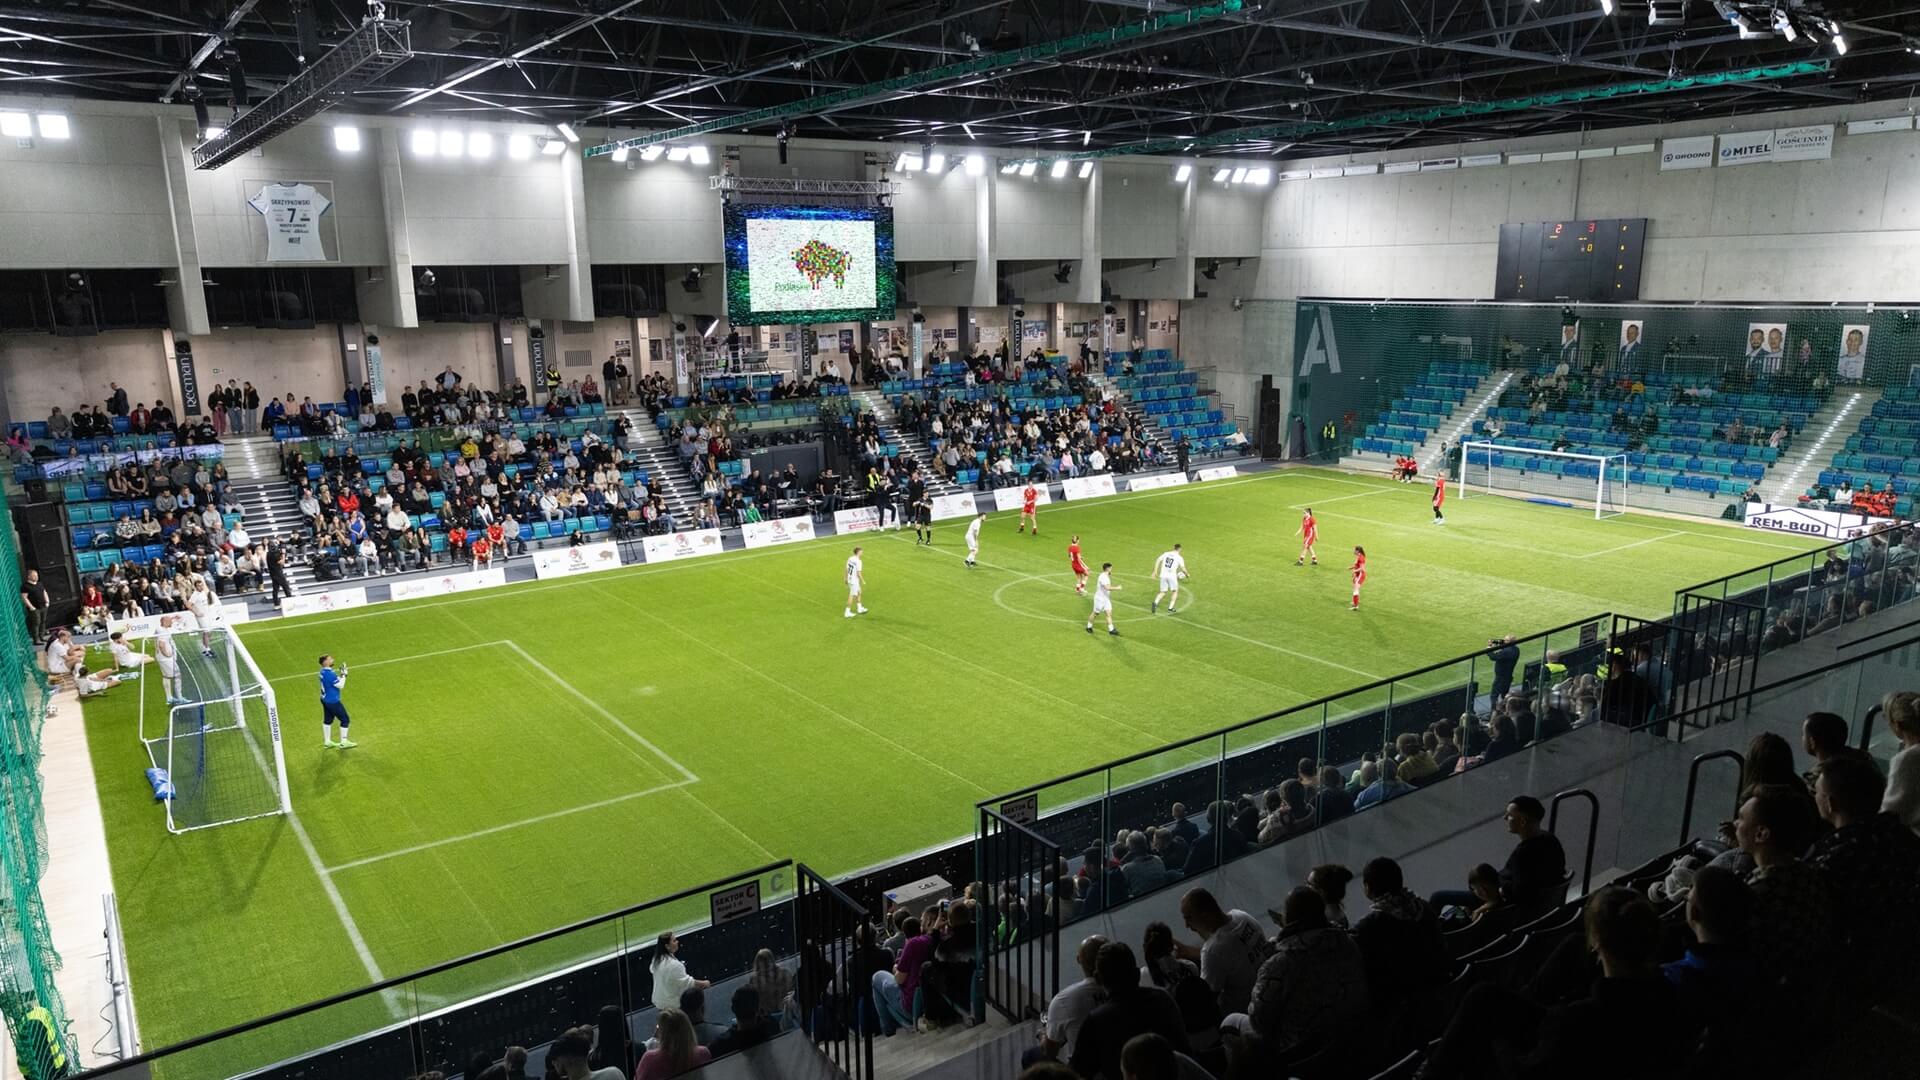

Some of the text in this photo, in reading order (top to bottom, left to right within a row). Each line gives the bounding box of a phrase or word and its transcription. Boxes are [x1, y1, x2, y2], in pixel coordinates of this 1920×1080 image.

[1733, 144, 1771, 156] MITEL
[287, 208, 296, 223] 7
[1555, 222, 1596, 234] 2 3
[1299, 305, 1341, 376] A
[1752, 516, 1821, 533] REM-BUD
[1027, 798, 1034, 809] C
[715, 884, 756, 906] SEKTOR C
